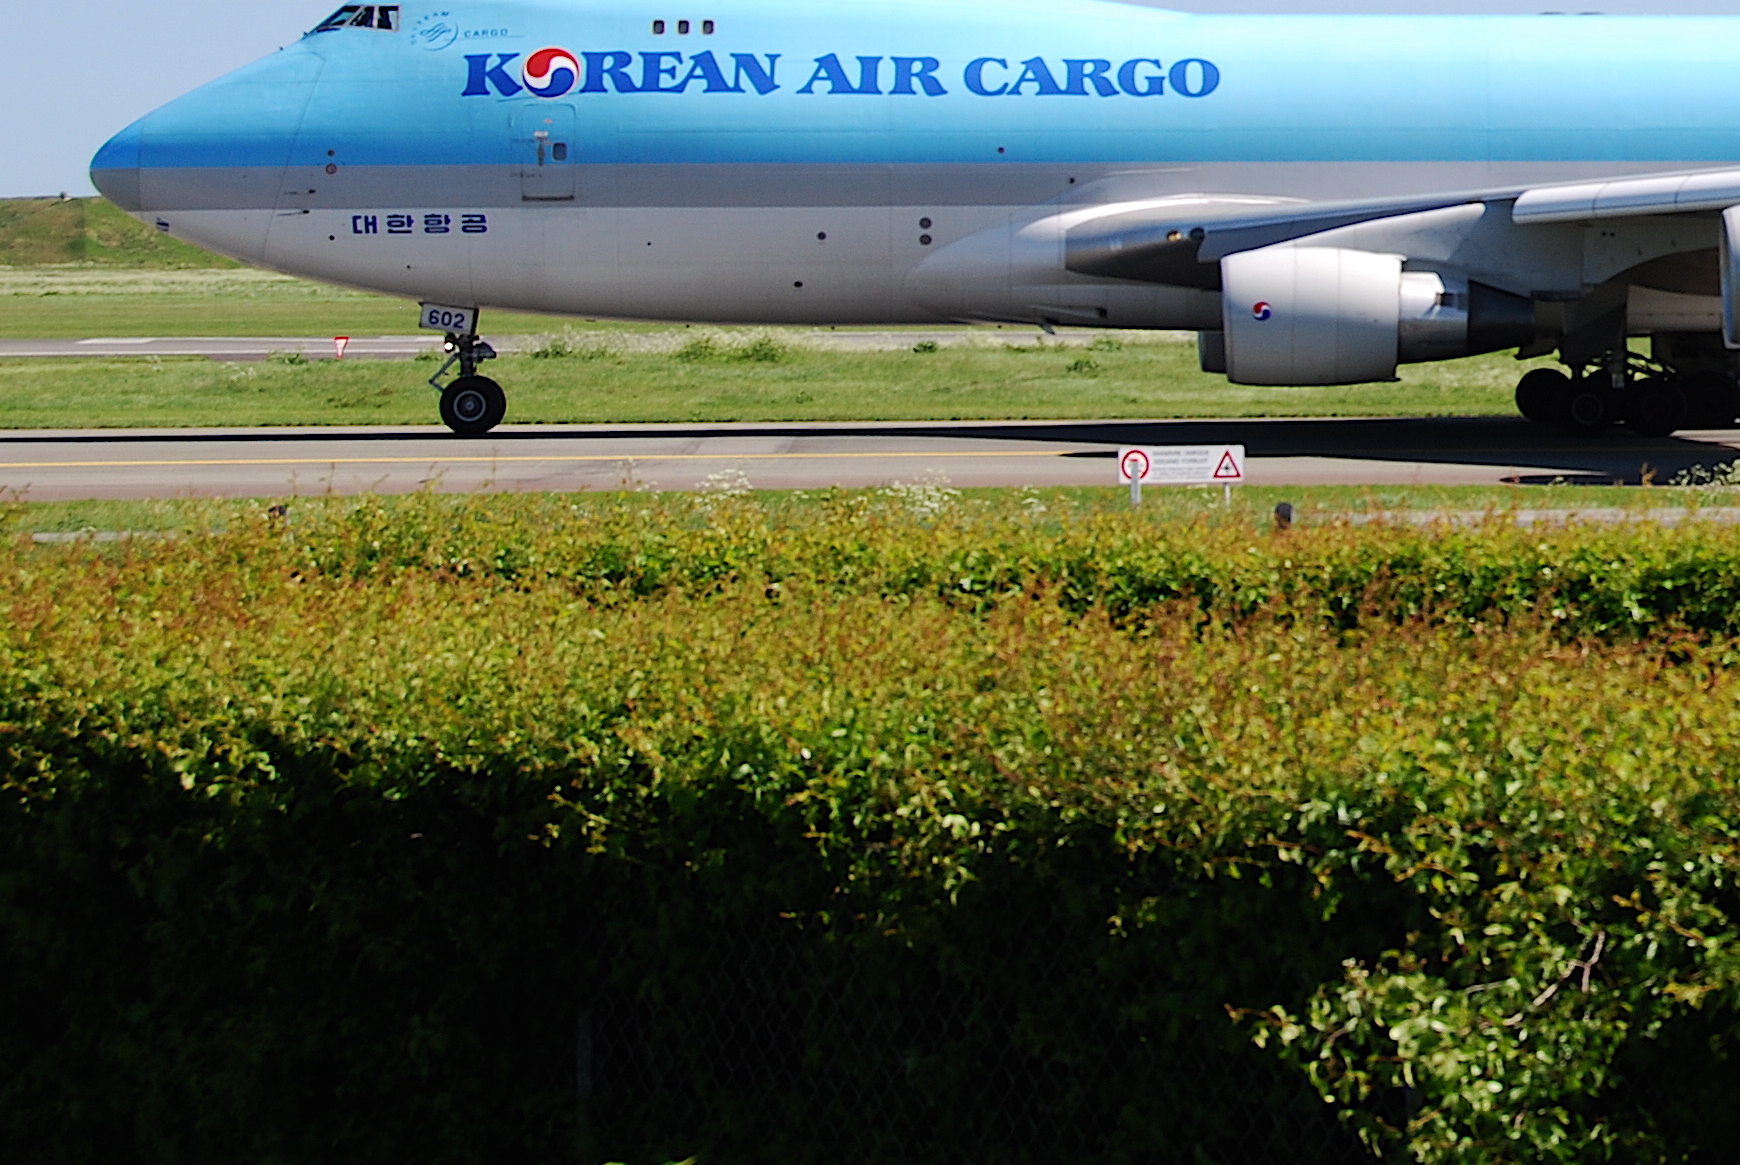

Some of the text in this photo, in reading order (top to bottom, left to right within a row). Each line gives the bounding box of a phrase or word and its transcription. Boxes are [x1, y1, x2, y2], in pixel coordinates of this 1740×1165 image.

[464, 28, 509, 38] CARGO
[796, 52, 949, 98] AIR
[963, 56, 1220, 99] CARGO
[352, 213, 488, 234] 대한항공
[428, 308, 465, 329] 602
